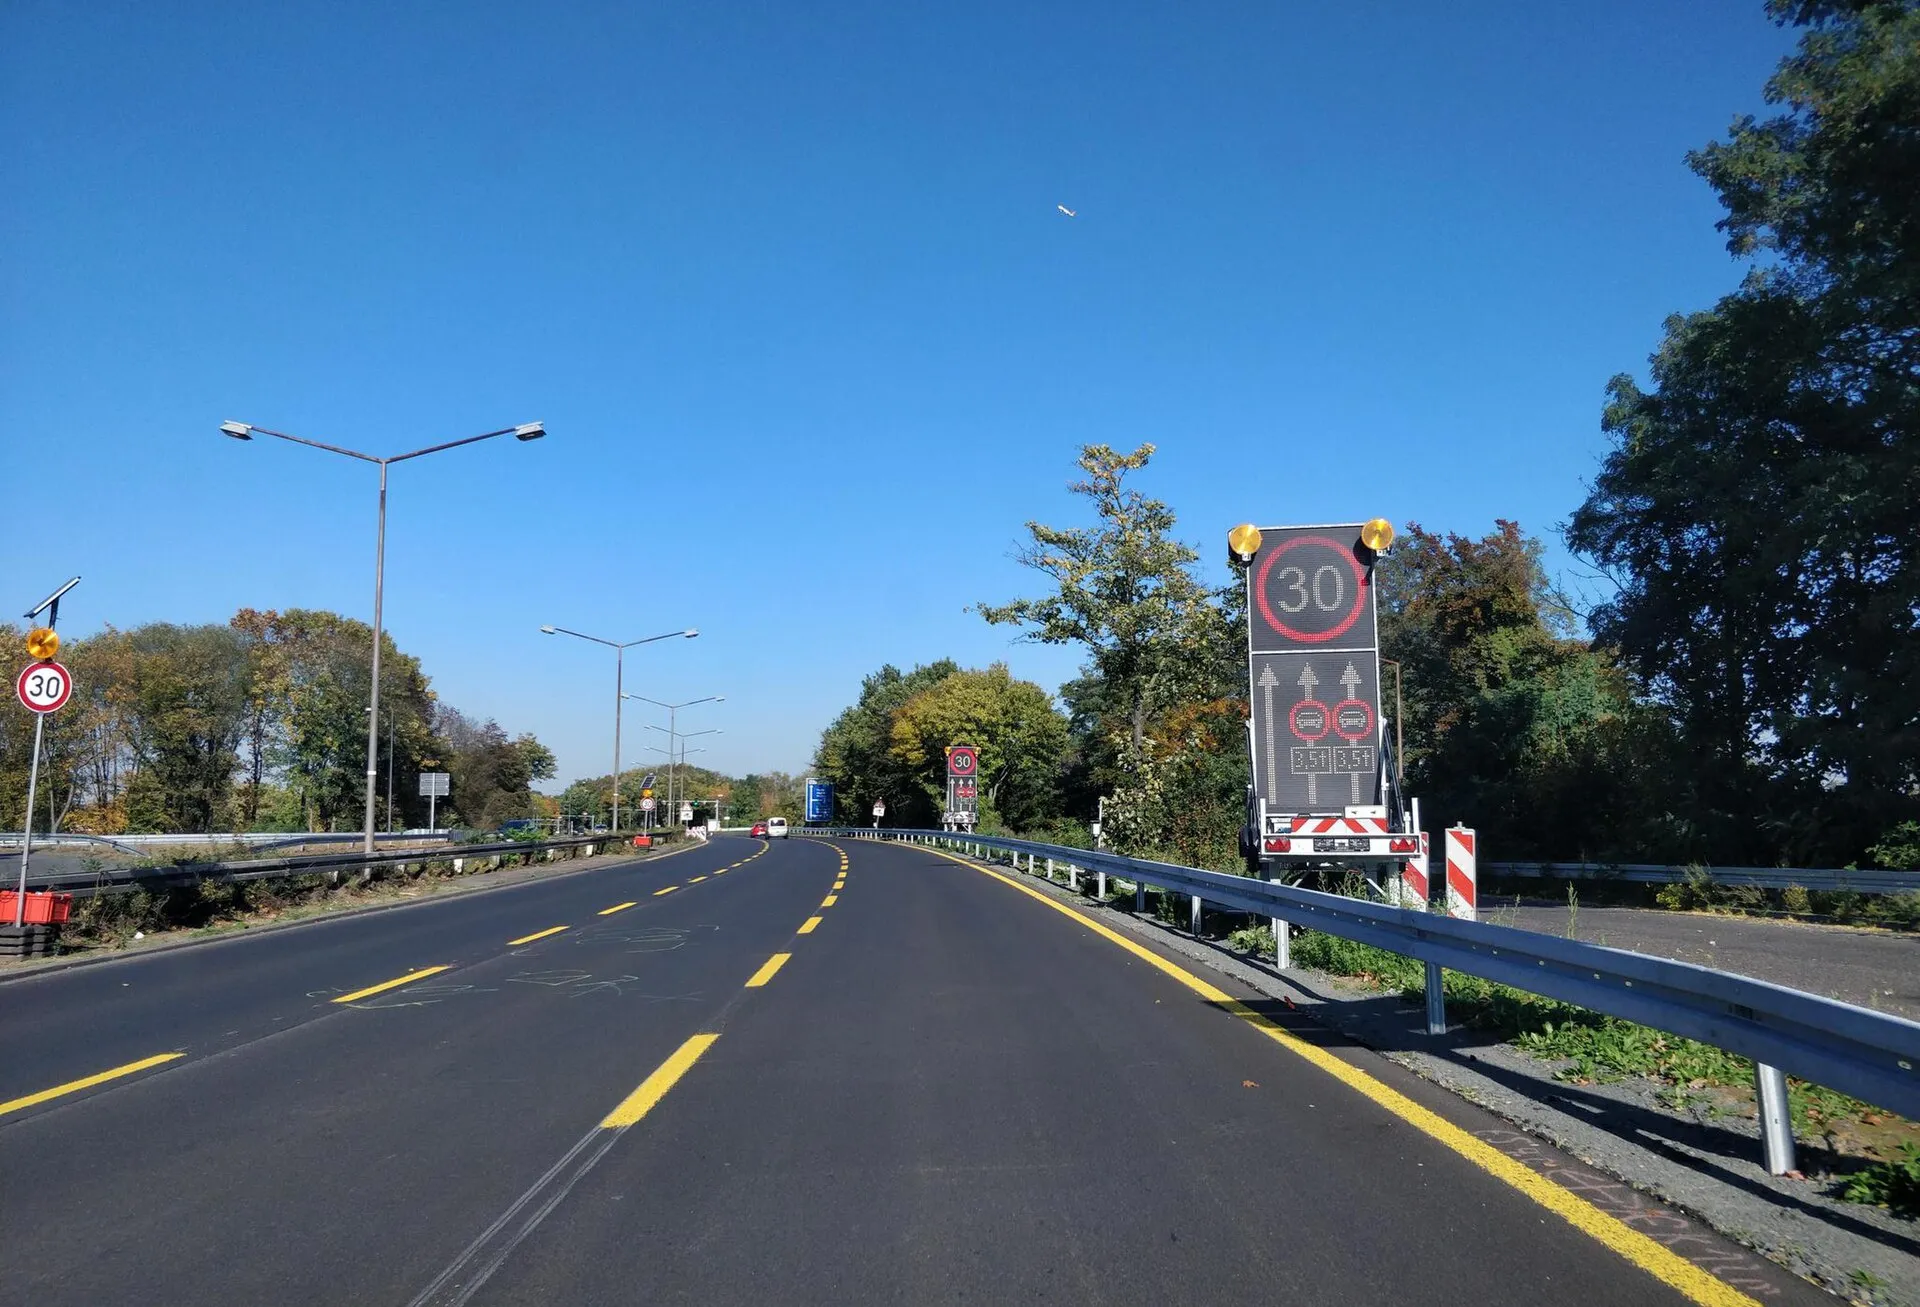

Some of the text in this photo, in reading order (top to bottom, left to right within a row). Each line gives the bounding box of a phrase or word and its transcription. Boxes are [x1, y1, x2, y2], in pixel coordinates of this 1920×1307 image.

[1278, 565, 1344, 613] 30
[29, 675, 60, 698] 30
[955, 756, 971, 768] 30
[1295, 751, 1327, 769] 3,5t
[1338, 750, 1370, 769] 3,5t
